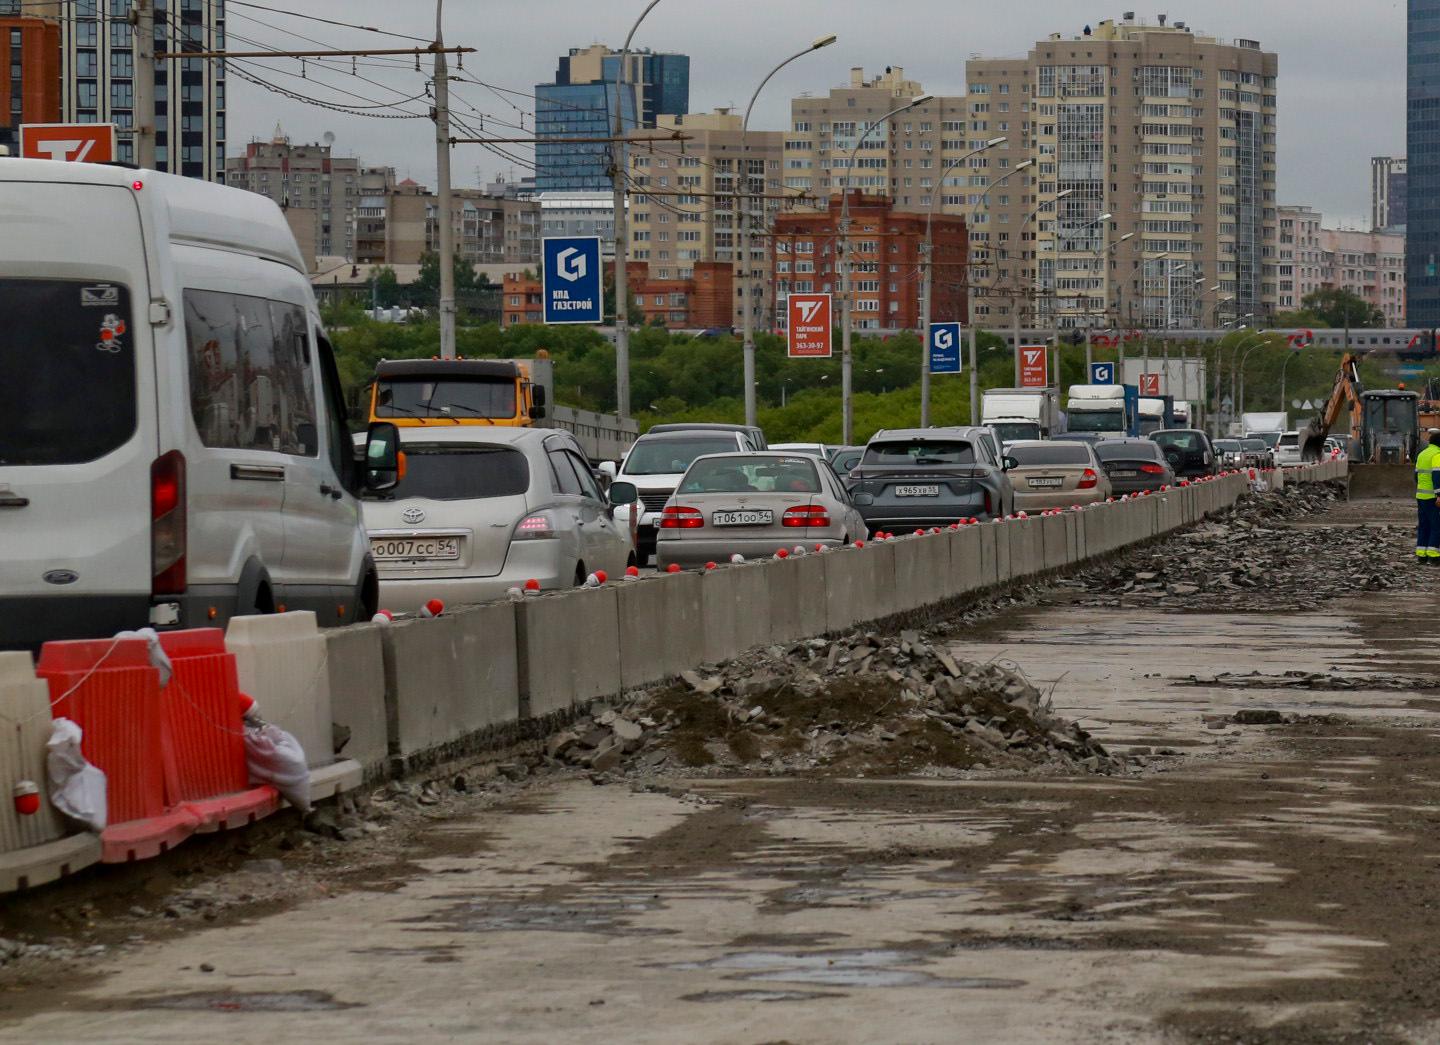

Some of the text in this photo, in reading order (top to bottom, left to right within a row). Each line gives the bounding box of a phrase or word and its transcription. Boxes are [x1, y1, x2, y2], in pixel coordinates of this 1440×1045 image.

[553, 298, 592, 311] ГАЗСТРОЙ
[717, 511, 769, 524] Т061ОО 54
[376, 541, 435, 556] О007СС
[438, 539, 452, 550] 54
